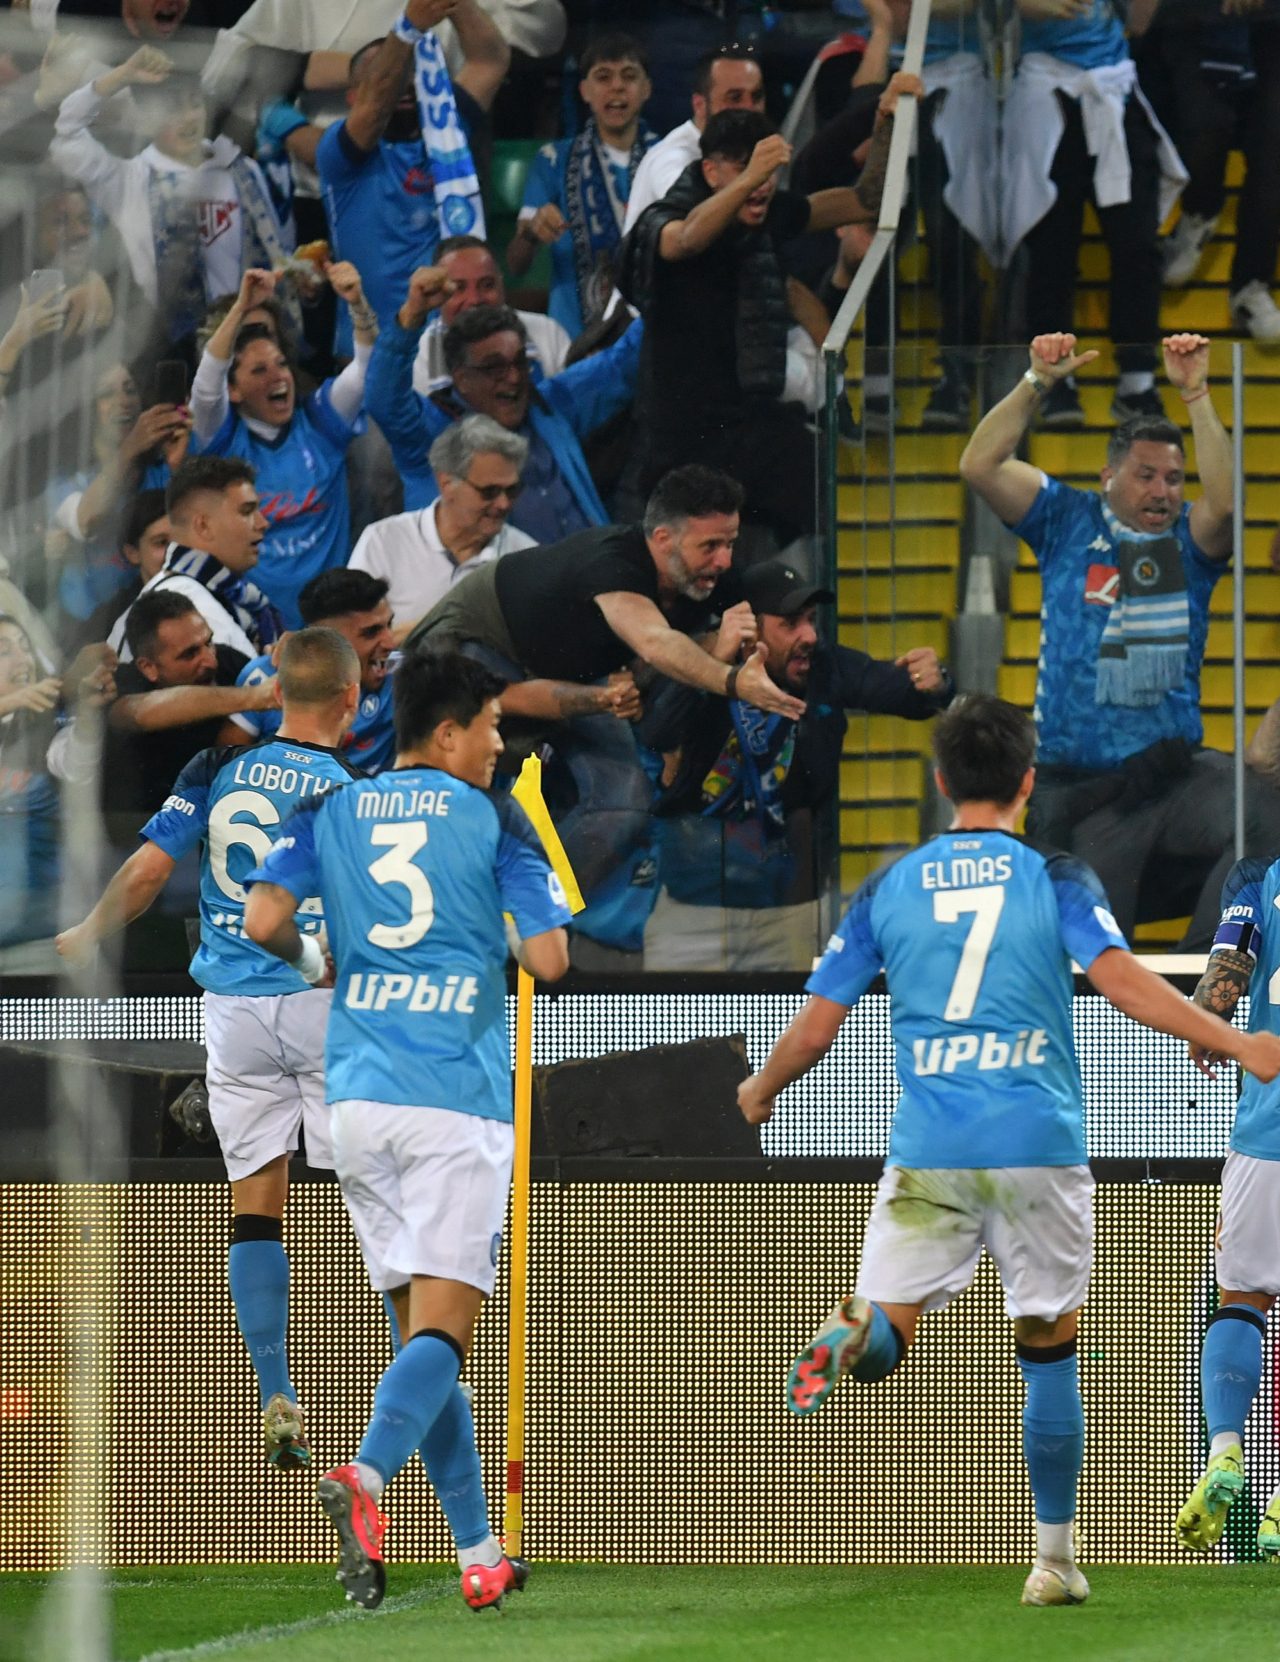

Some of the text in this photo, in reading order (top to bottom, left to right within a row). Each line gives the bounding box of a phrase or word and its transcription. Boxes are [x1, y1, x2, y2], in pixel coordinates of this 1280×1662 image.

[356, 790, 452, 819] MINJAE
[367, 820, 436, 949] 3
[921, 855, 1012, 889] ELMAS
[933, 884, 1005, 1021] 7
